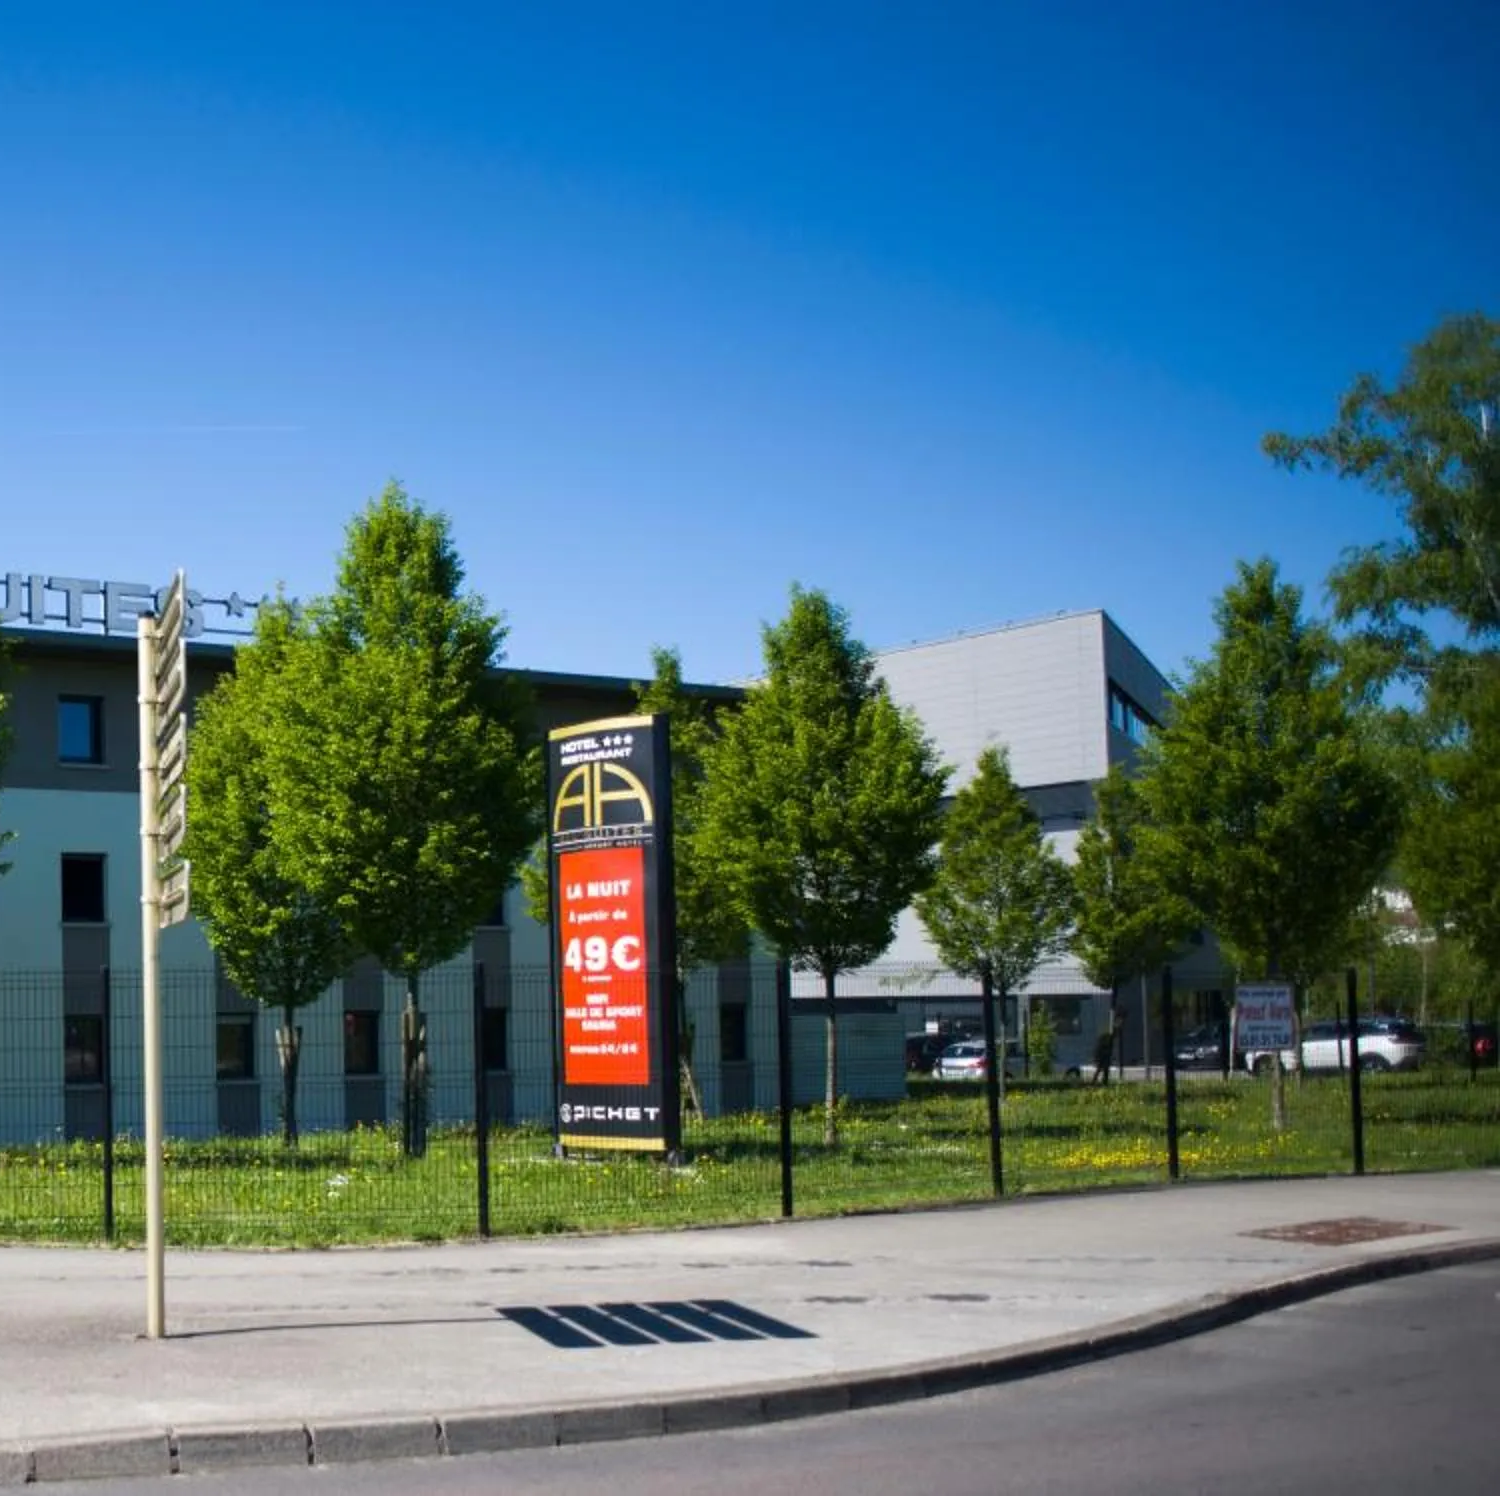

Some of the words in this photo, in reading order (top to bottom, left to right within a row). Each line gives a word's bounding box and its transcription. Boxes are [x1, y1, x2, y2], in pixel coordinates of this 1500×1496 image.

[561, 738, 598, 754] HOTEL
[566, 883, 583, 901] LA
[587, 879, 631, 897] NUIT
[565, 935, 641, 973] 49€
